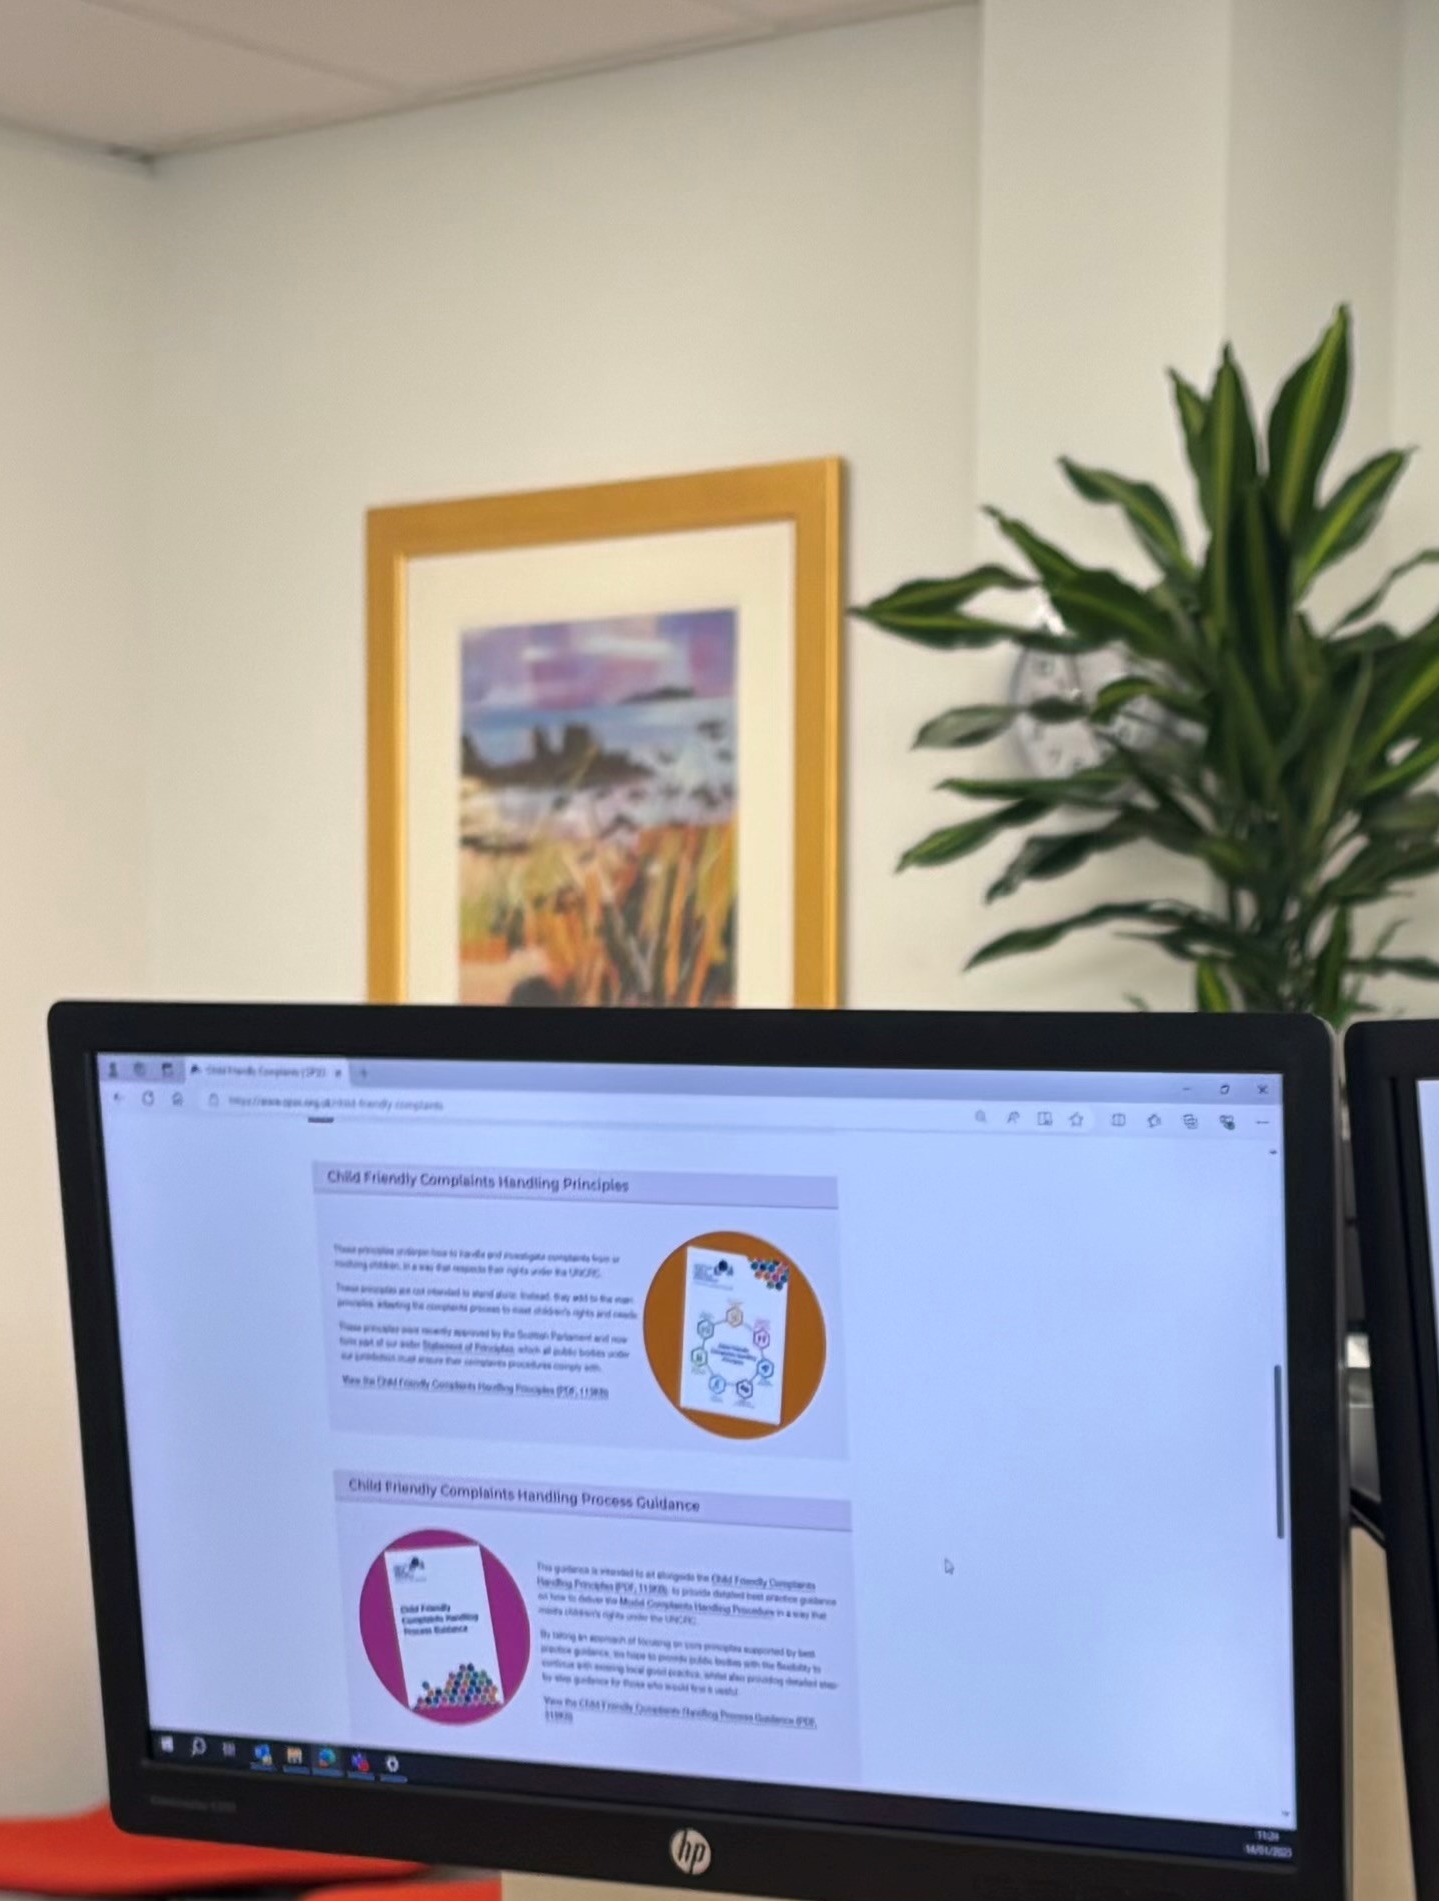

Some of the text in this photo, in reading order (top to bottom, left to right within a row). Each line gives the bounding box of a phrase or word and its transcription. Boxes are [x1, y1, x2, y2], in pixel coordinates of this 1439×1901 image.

[328, 1169, 629, 1197] Child Friendly Complaints Handling Principles
[349, 1478, 700, 1512] Child Friendly Complaints Handling Process Guidance
[674, 1829, 709, 1876] hp
